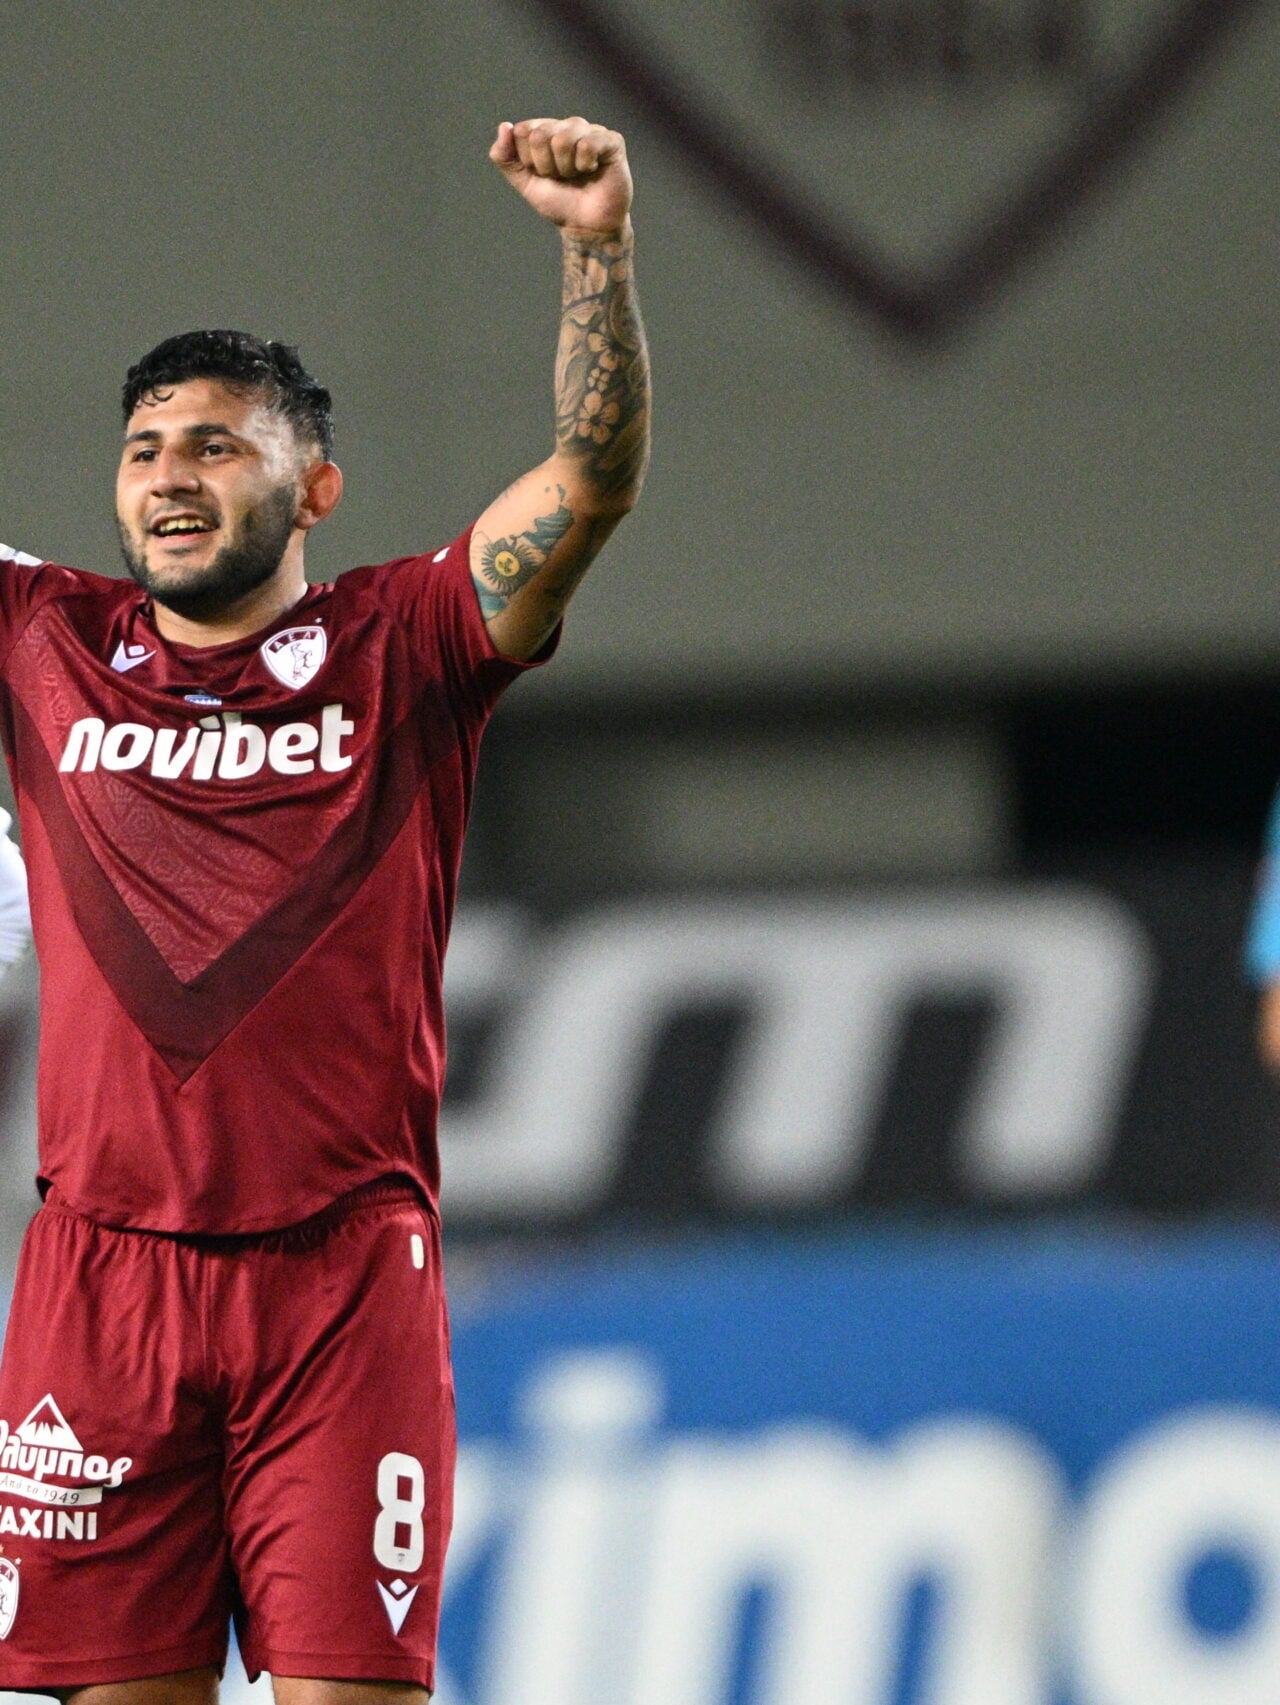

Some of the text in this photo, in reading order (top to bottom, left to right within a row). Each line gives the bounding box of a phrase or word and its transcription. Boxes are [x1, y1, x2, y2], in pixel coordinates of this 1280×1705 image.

[59, 703, 354, 780] novibet
[44, 1489, 81, 1505] 1949
[373, 1452, 425, 1573] 8
